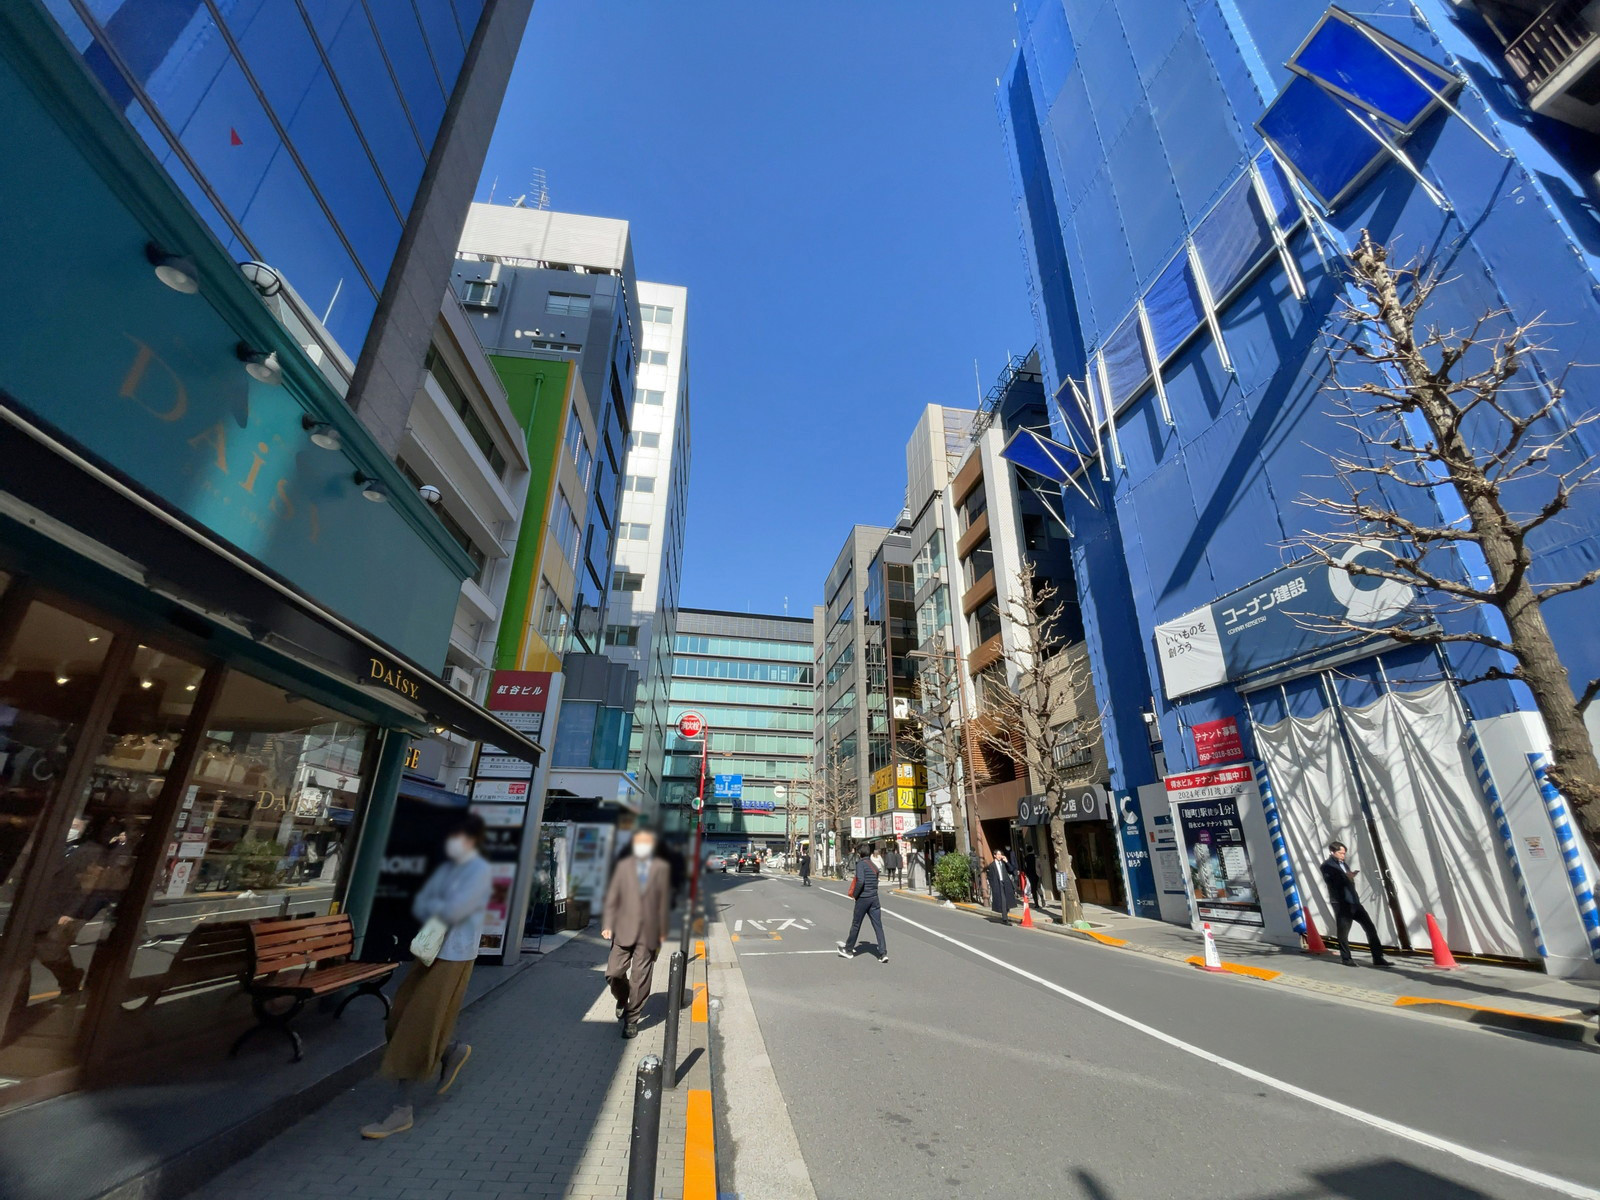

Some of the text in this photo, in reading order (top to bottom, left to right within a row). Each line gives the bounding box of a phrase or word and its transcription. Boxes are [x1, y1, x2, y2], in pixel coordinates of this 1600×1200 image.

[1221, 576, 1308, 626] コーナン建設
[1165, 622, 1207, 646] いいものを
[1168, 641, 1193, 659] 創ろう
[496, 685, 542, 696] 紅谷ビル
[680, 721, 701, 731] 消火栓
[1194, 725, 1238, 743] テナント募集
